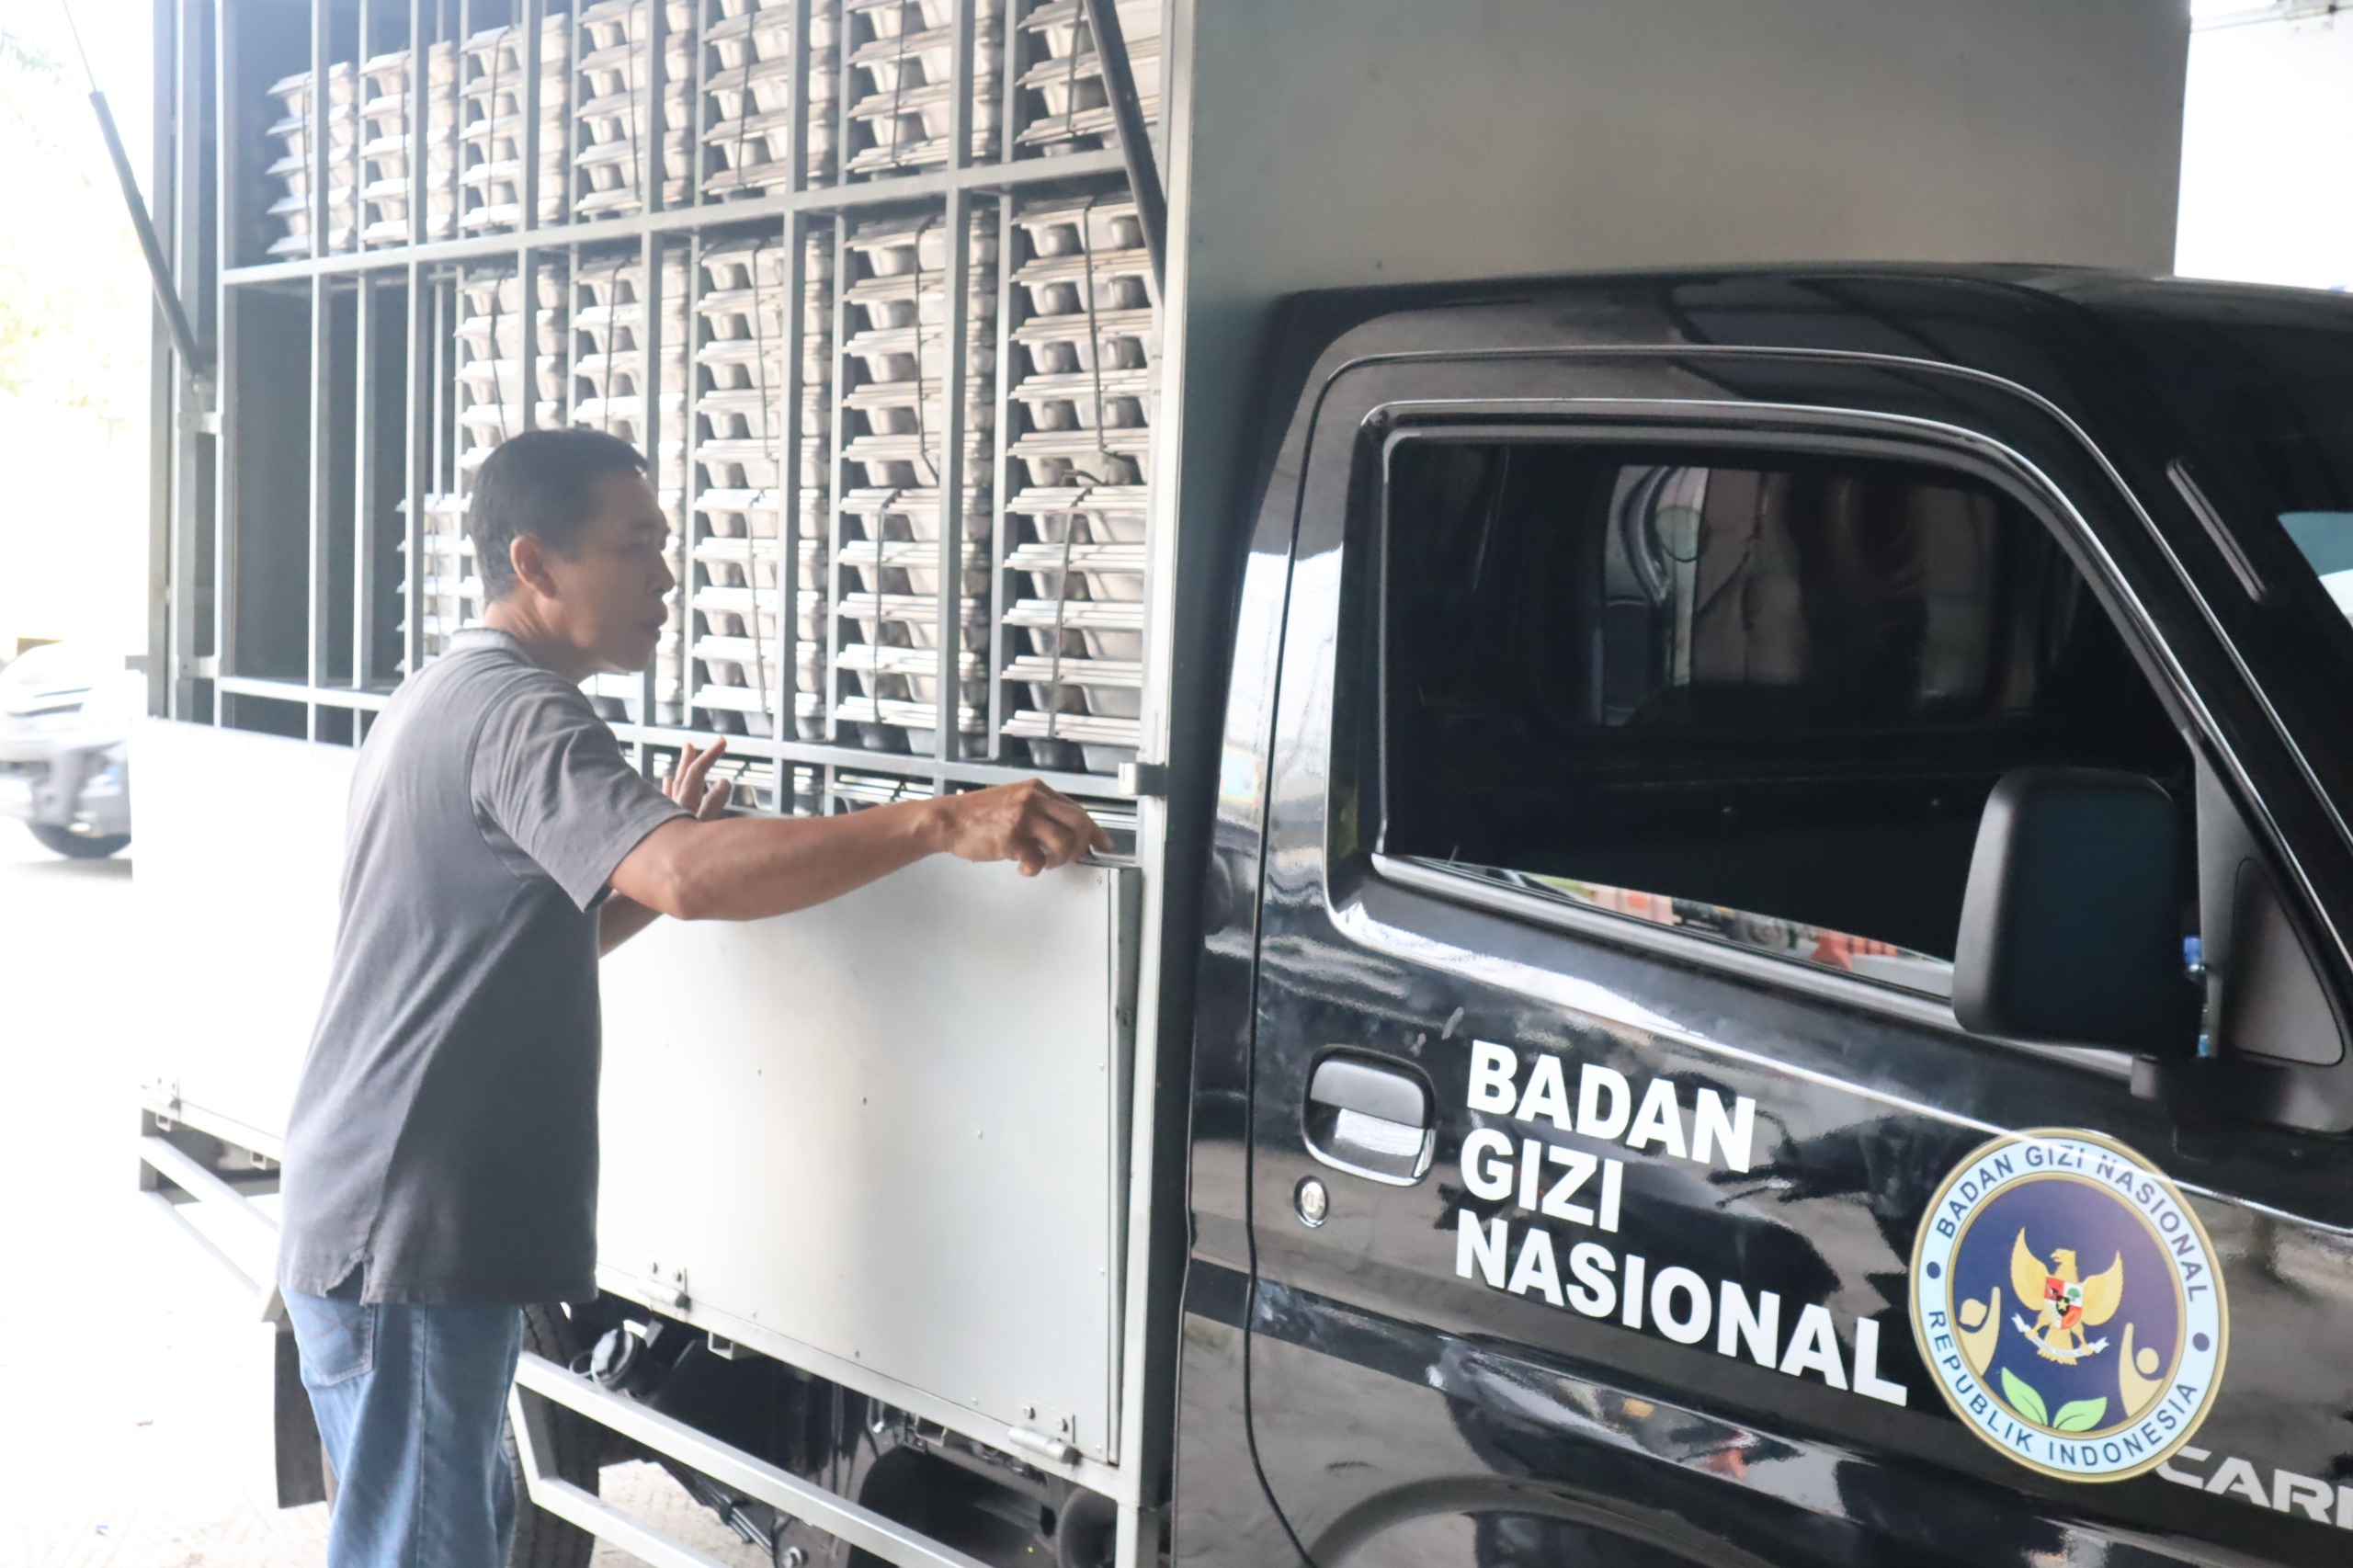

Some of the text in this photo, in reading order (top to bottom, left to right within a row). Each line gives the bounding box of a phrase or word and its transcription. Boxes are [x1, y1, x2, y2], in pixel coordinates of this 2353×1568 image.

[1461, 1128, 1623, 1233] GIZI
[1467, 1040, 1756, 1173] BADAN
[1937, 1145, 2208, 1302] BADAN GIZI NASIONAL
[1456, 1209, 1907, 1406] NASIONAL
[1928, 1311, 2198, 1467] REPUBLIK INDONESIA
